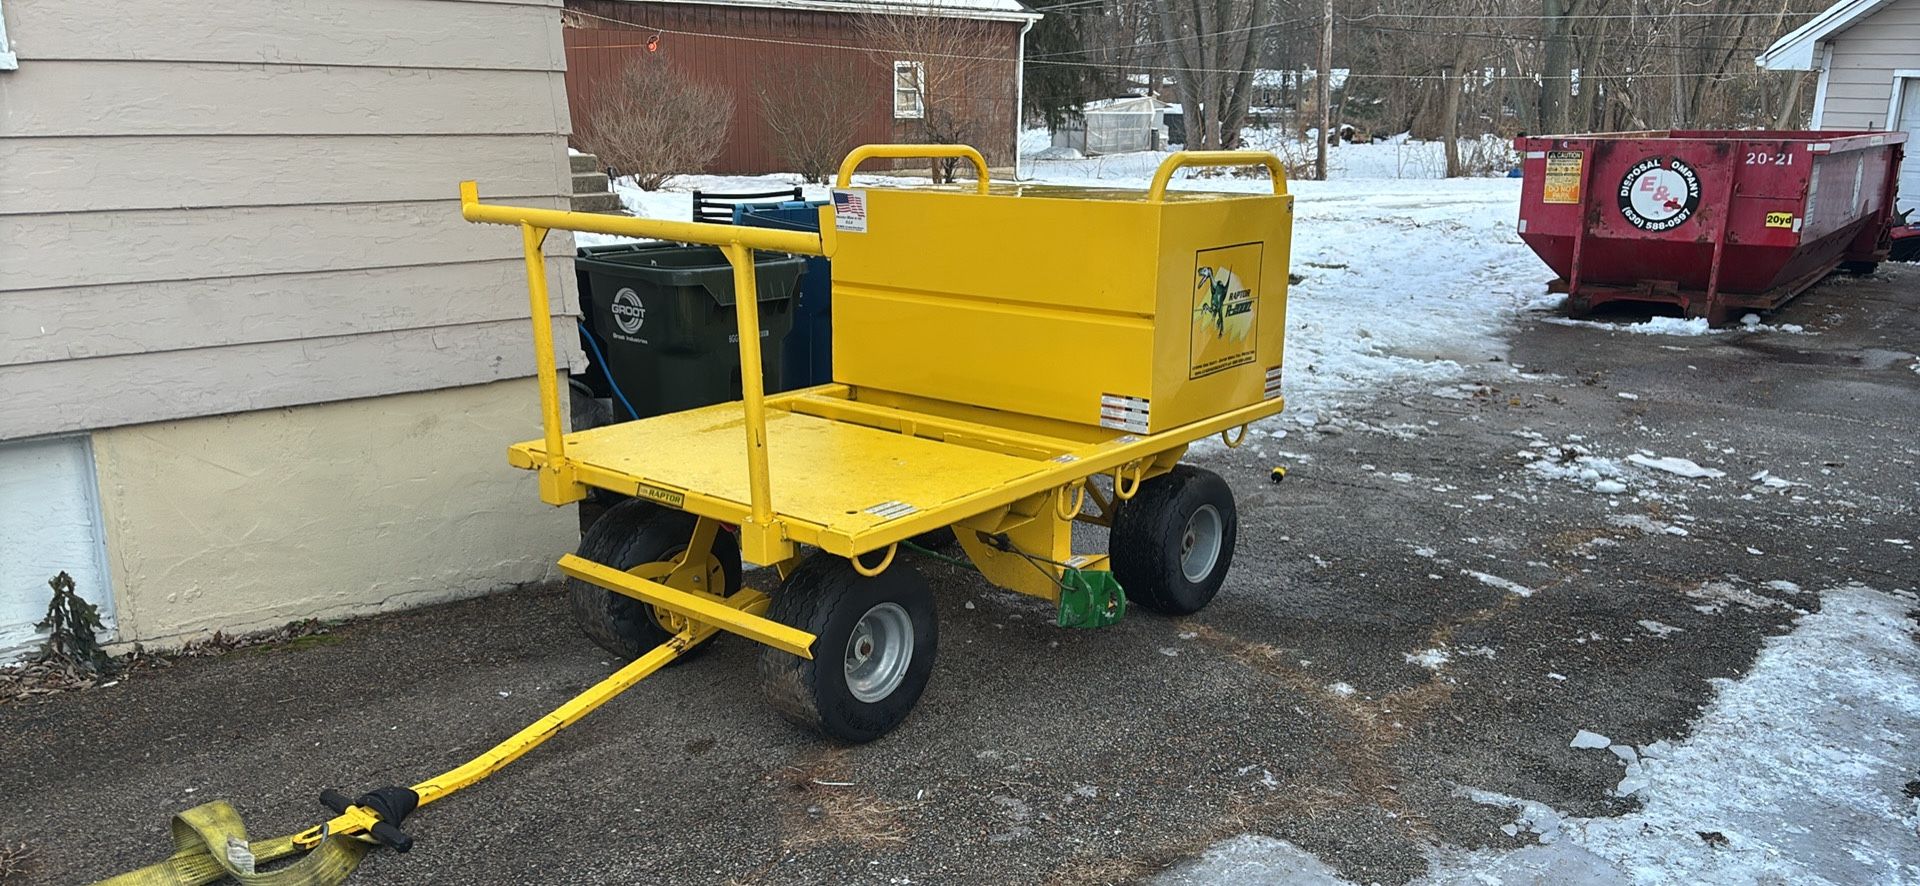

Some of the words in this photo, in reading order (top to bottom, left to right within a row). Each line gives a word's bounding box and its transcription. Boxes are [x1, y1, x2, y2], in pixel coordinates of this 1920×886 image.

[1745, 152, 1793, 166] 20-21
[1671, 161, 1699, 198] OMPANY
[1621, 206, 1645, 228] (630)
[1645, 208, 1691, 230] 588-0597
[1767, 215, 1792, 225] 20yd
[611, 303, 646, 318] GROOT
[648, 489, 681, 504] RAPTOR
